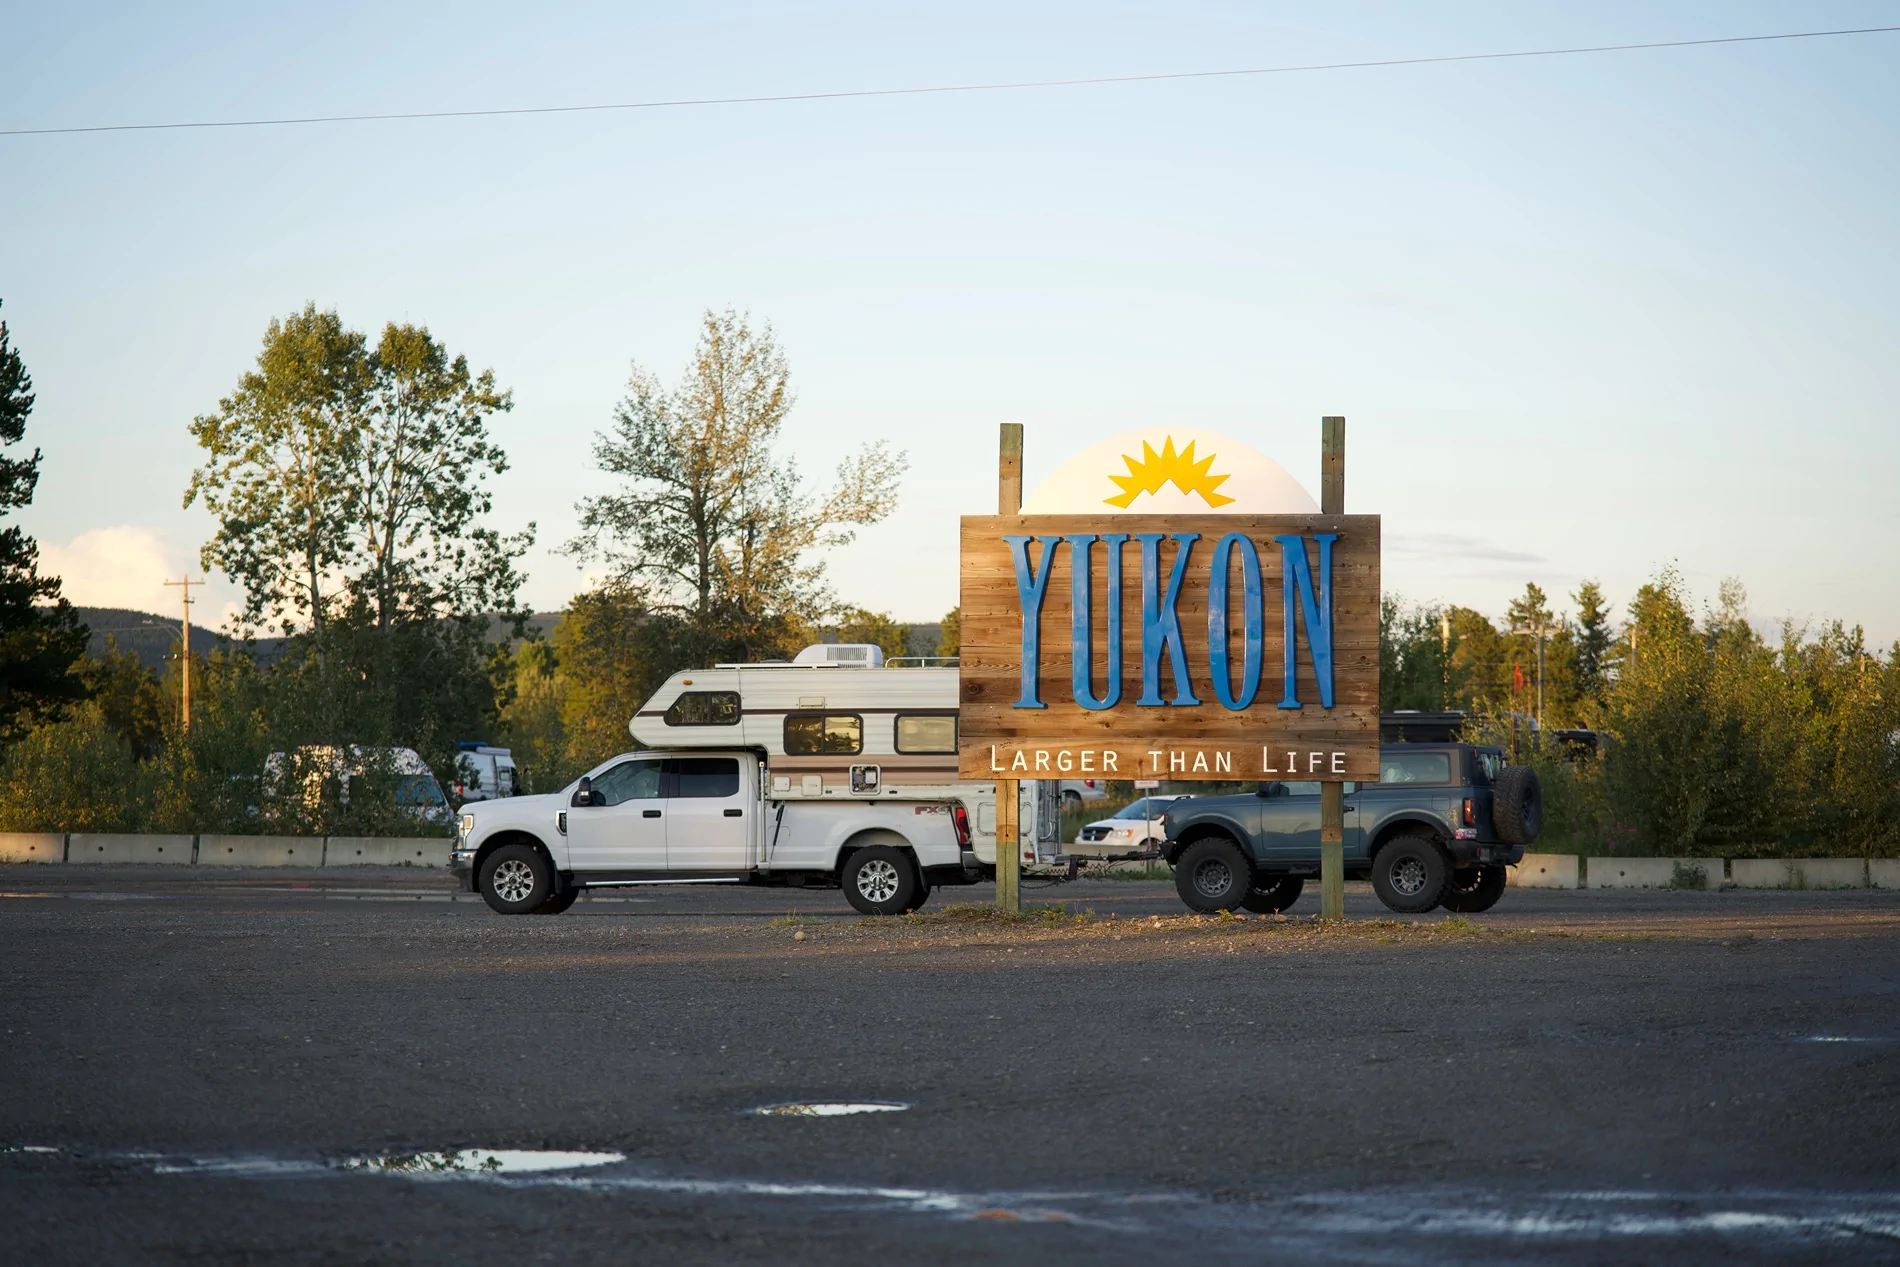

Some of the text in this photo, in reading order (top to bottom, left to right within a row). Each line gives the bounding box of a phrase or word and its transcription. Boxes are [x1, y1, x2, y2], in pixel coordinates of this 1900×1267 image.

[1003, 533, 1340, 711] YUKON
[991, 744, 1346, 773] LARGER THAN LIFE
